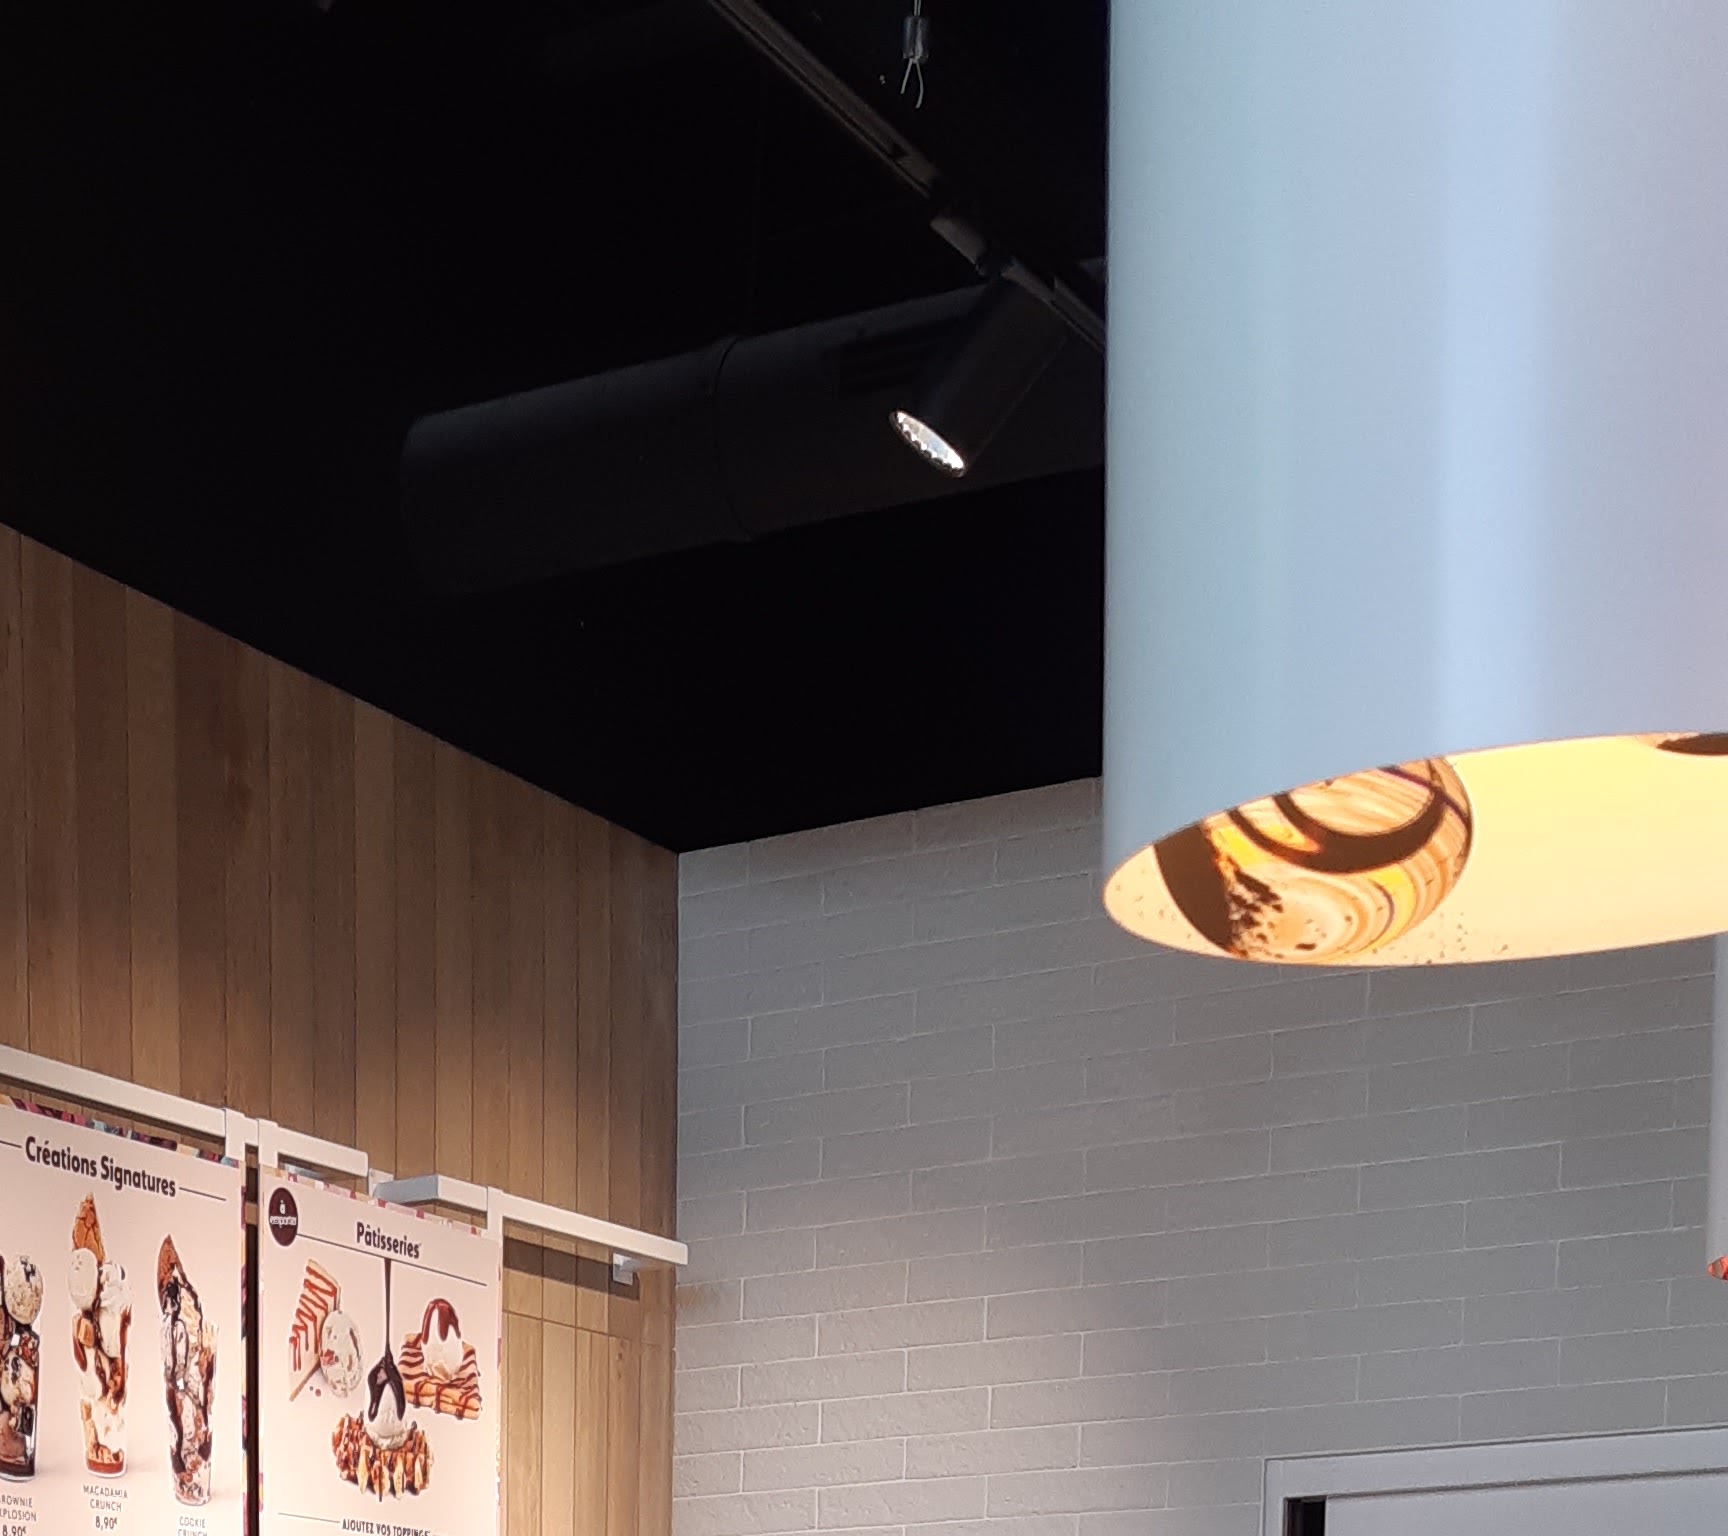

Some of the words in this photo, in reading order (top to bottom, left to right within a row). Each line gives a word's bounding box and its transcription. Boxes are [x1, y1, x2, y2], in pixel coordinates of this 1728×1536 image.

[25, 1136, 97, 1177] Créations
[101, 1156, 176, 1197] Signatures
[83, 1485, 128, 1499] MACADAMIA
[90, 1499, 121, 1512] CRUNCH
[179, 1516, 205, 1528] COOKIE
[342, 1519, 374, 1534] AJOUTEZ
[377, 1524, 391, 1536] VOS
